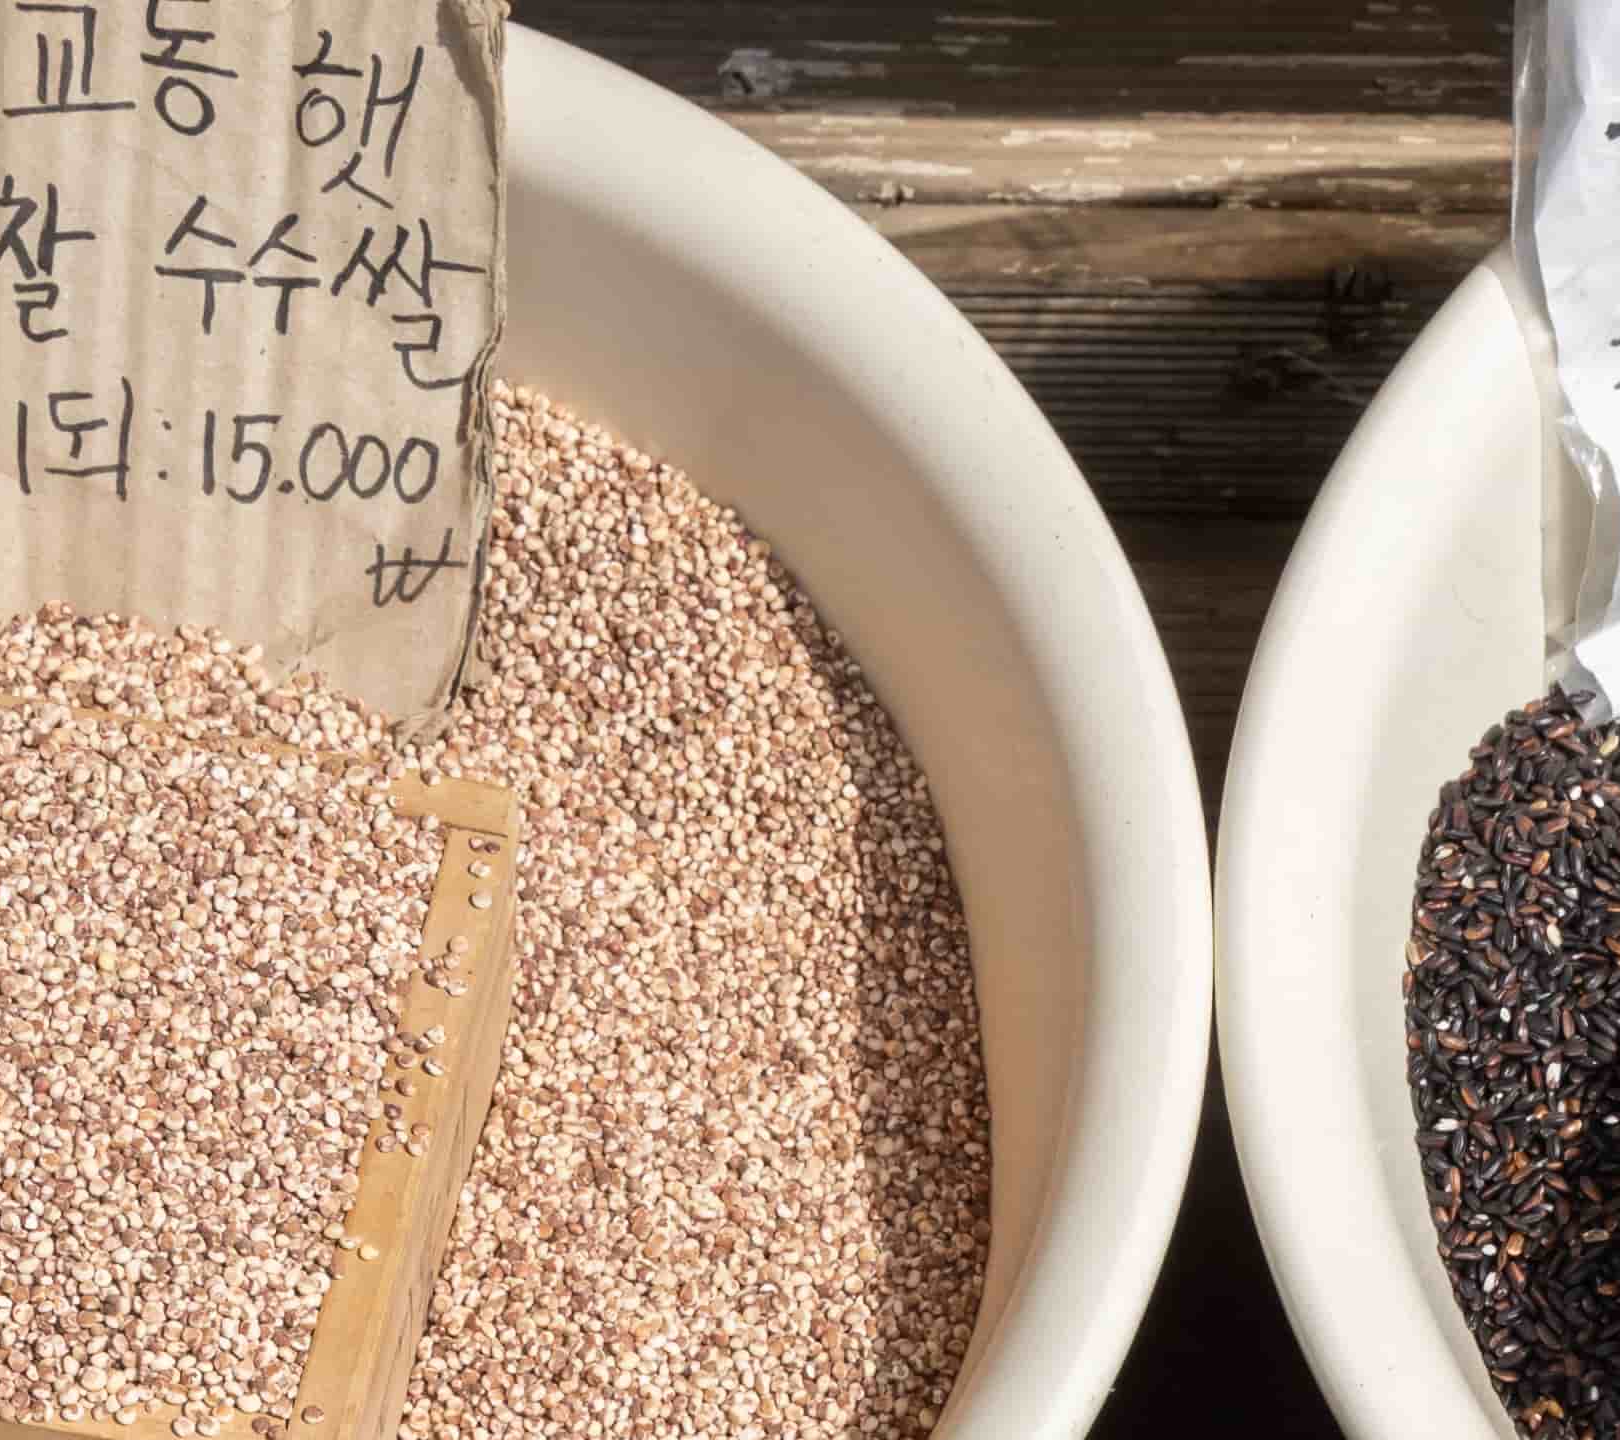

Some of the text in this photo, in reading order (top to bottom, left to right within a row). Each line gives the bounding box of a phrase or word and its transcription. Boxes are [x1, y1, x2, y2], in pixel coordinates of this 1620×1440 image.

[2, 0, 425, 210] 교동 햇
[155, 195, 486, 390] 수수쌀
